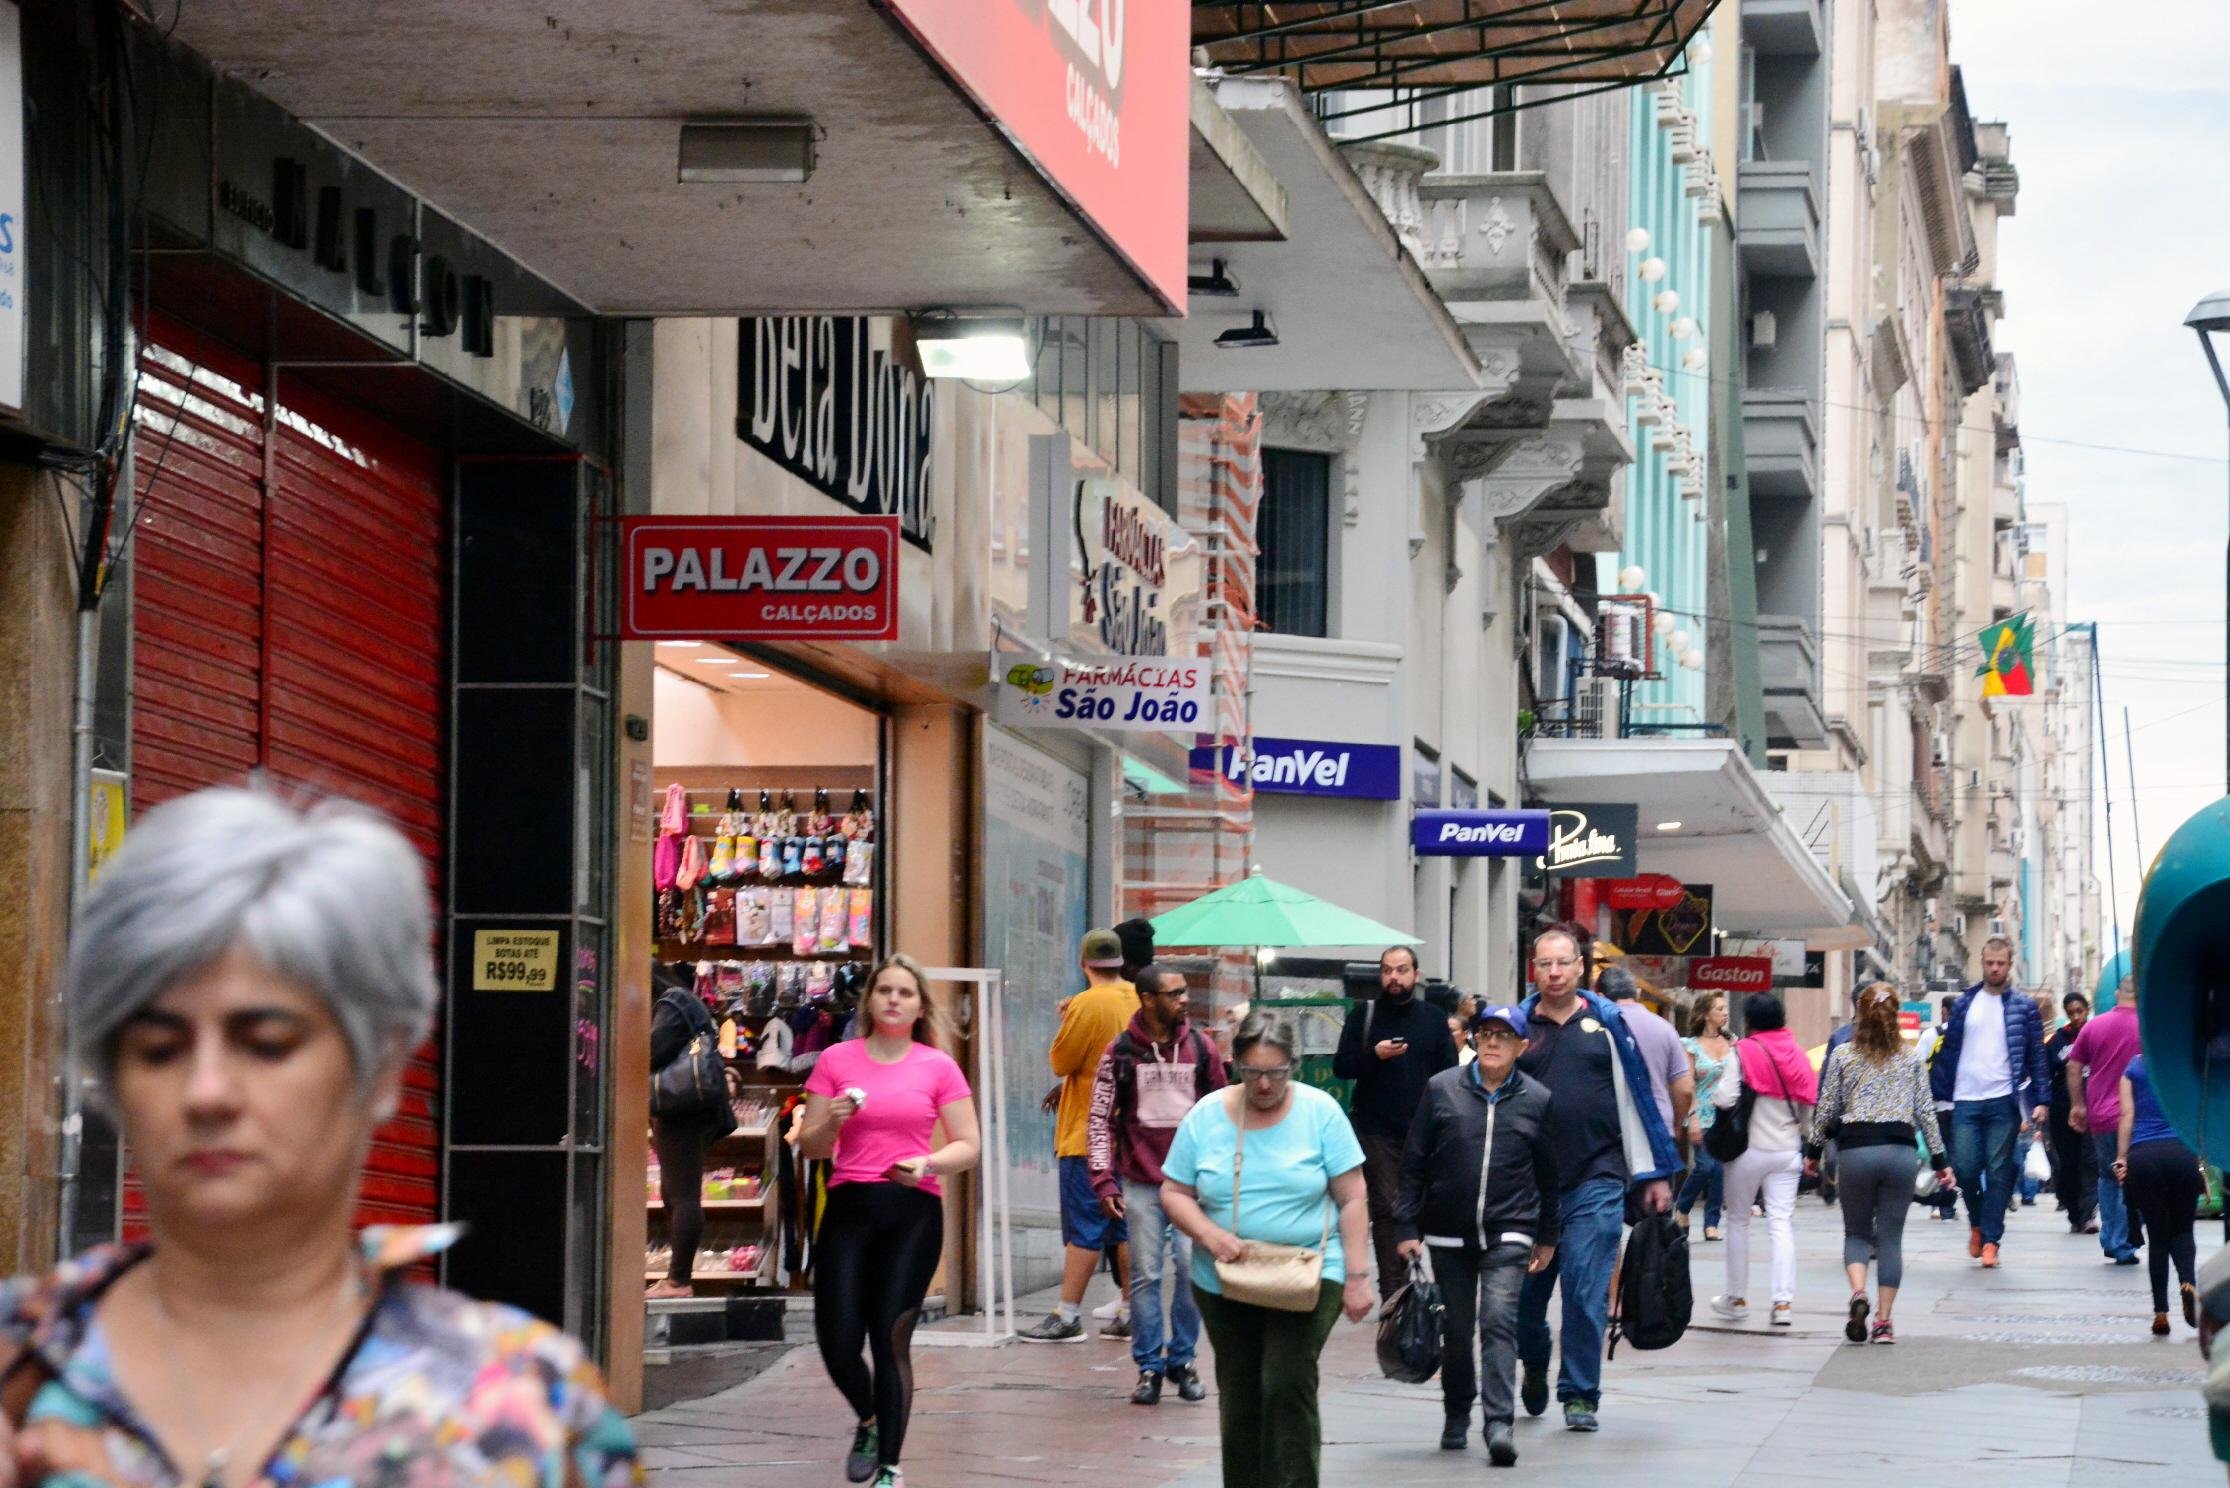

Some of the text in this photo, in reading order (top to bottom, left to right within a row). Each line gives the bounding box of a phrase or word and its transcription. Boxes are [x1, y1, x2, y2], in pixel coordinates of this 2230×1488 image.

[1066, 62, 1119, 169] CALÇADOS
[643, 547, 880, 592] PALAZZO
[761, 604, 877, 623] CALÇADOS
[1062, 662, 1197, 689] FARMÁCIAS
[1056, 687, 1198, 723] São João
[1229, 749, 1350, 787] PanVel
[1439, 823, 1525, 843] PanVel
[1696, 964, 1764, 984] Gaston
